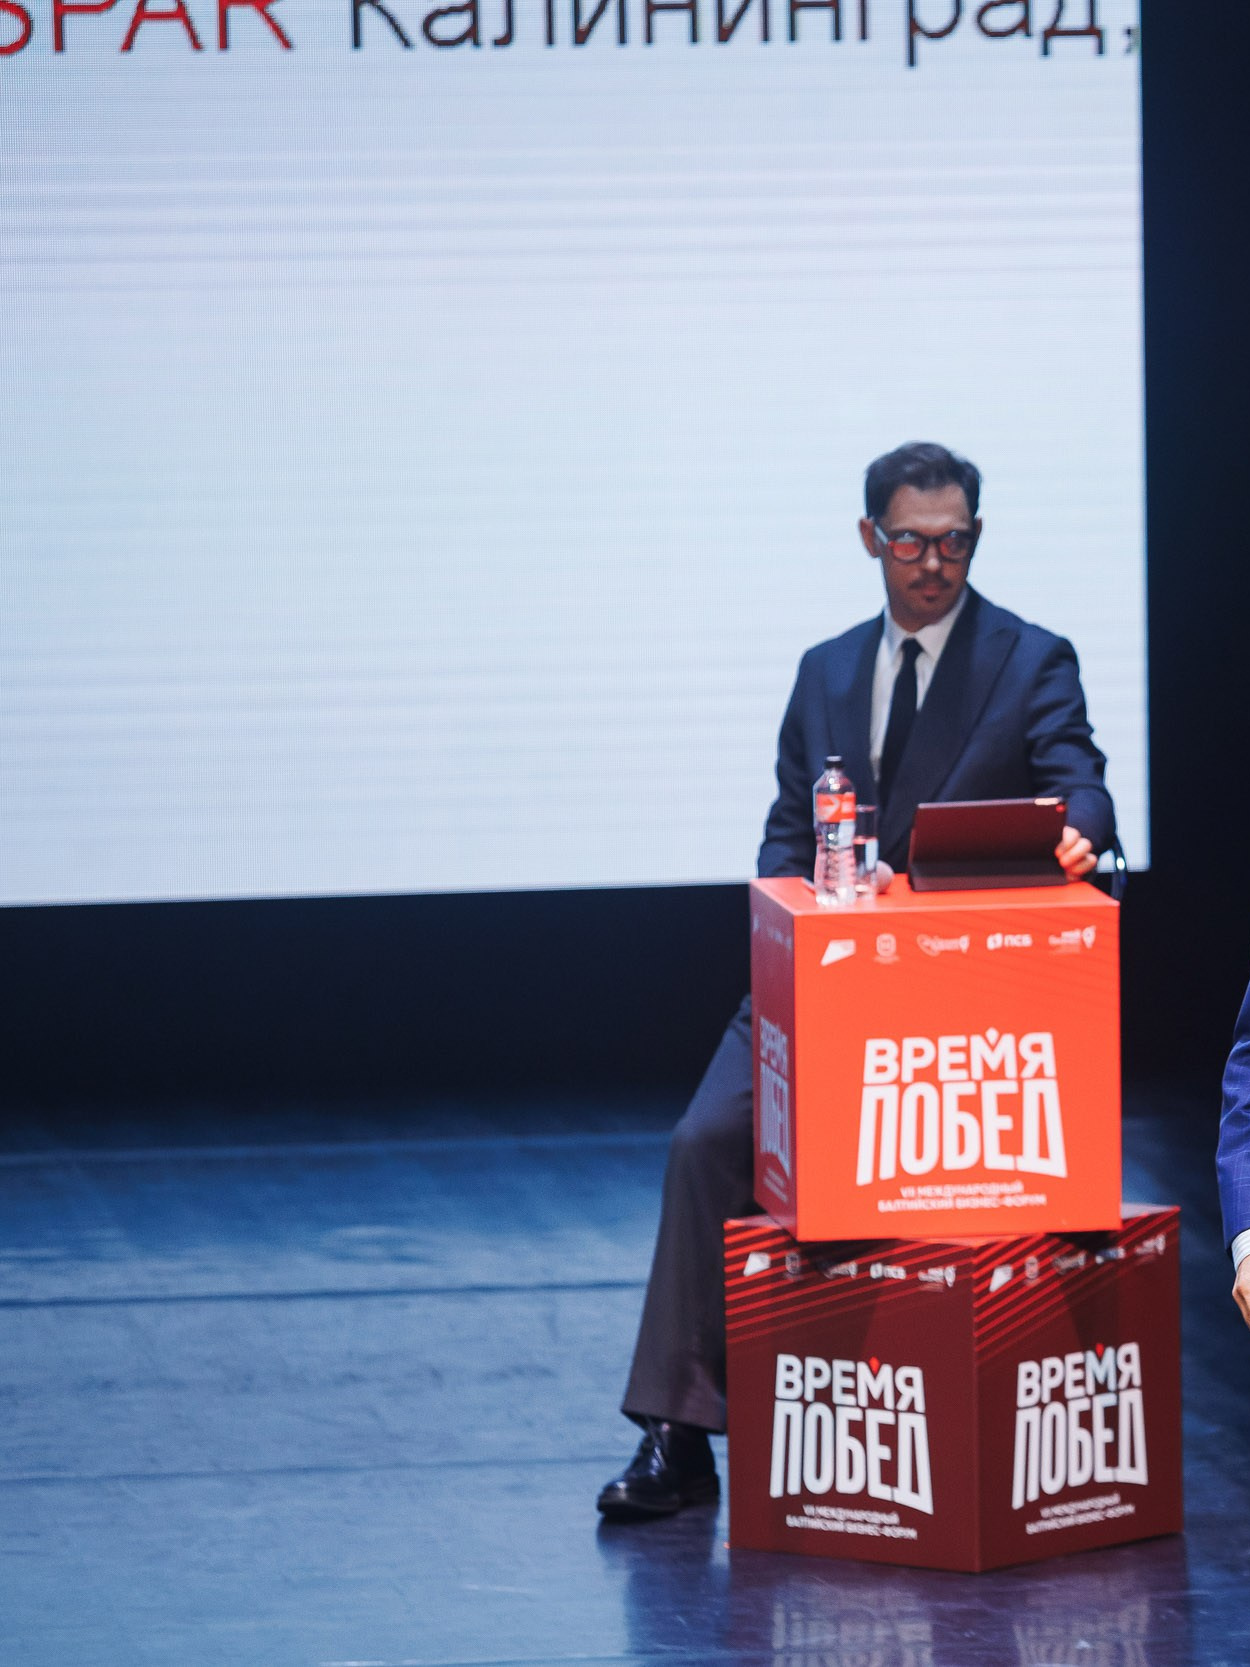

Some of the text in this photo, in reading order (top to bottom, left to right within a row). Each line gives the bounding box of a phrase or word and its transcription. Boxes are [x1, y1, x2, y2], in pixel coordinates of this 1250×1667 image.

[0, 0, 293, 55] PAR
[863, 1031, 1057, 1085] ВРЕМЯ
[856, 1078, 1068, 1186] ПОБЕД
[775, 1353, 926, 1413] ВРЕМЯ
[1016, 1341, 1142, 1409] ВРЕМЯ
[769, 1400, 934, 1516] ПОБЕД
[1011, 1387, 1148, 1511] ПОБЕД
